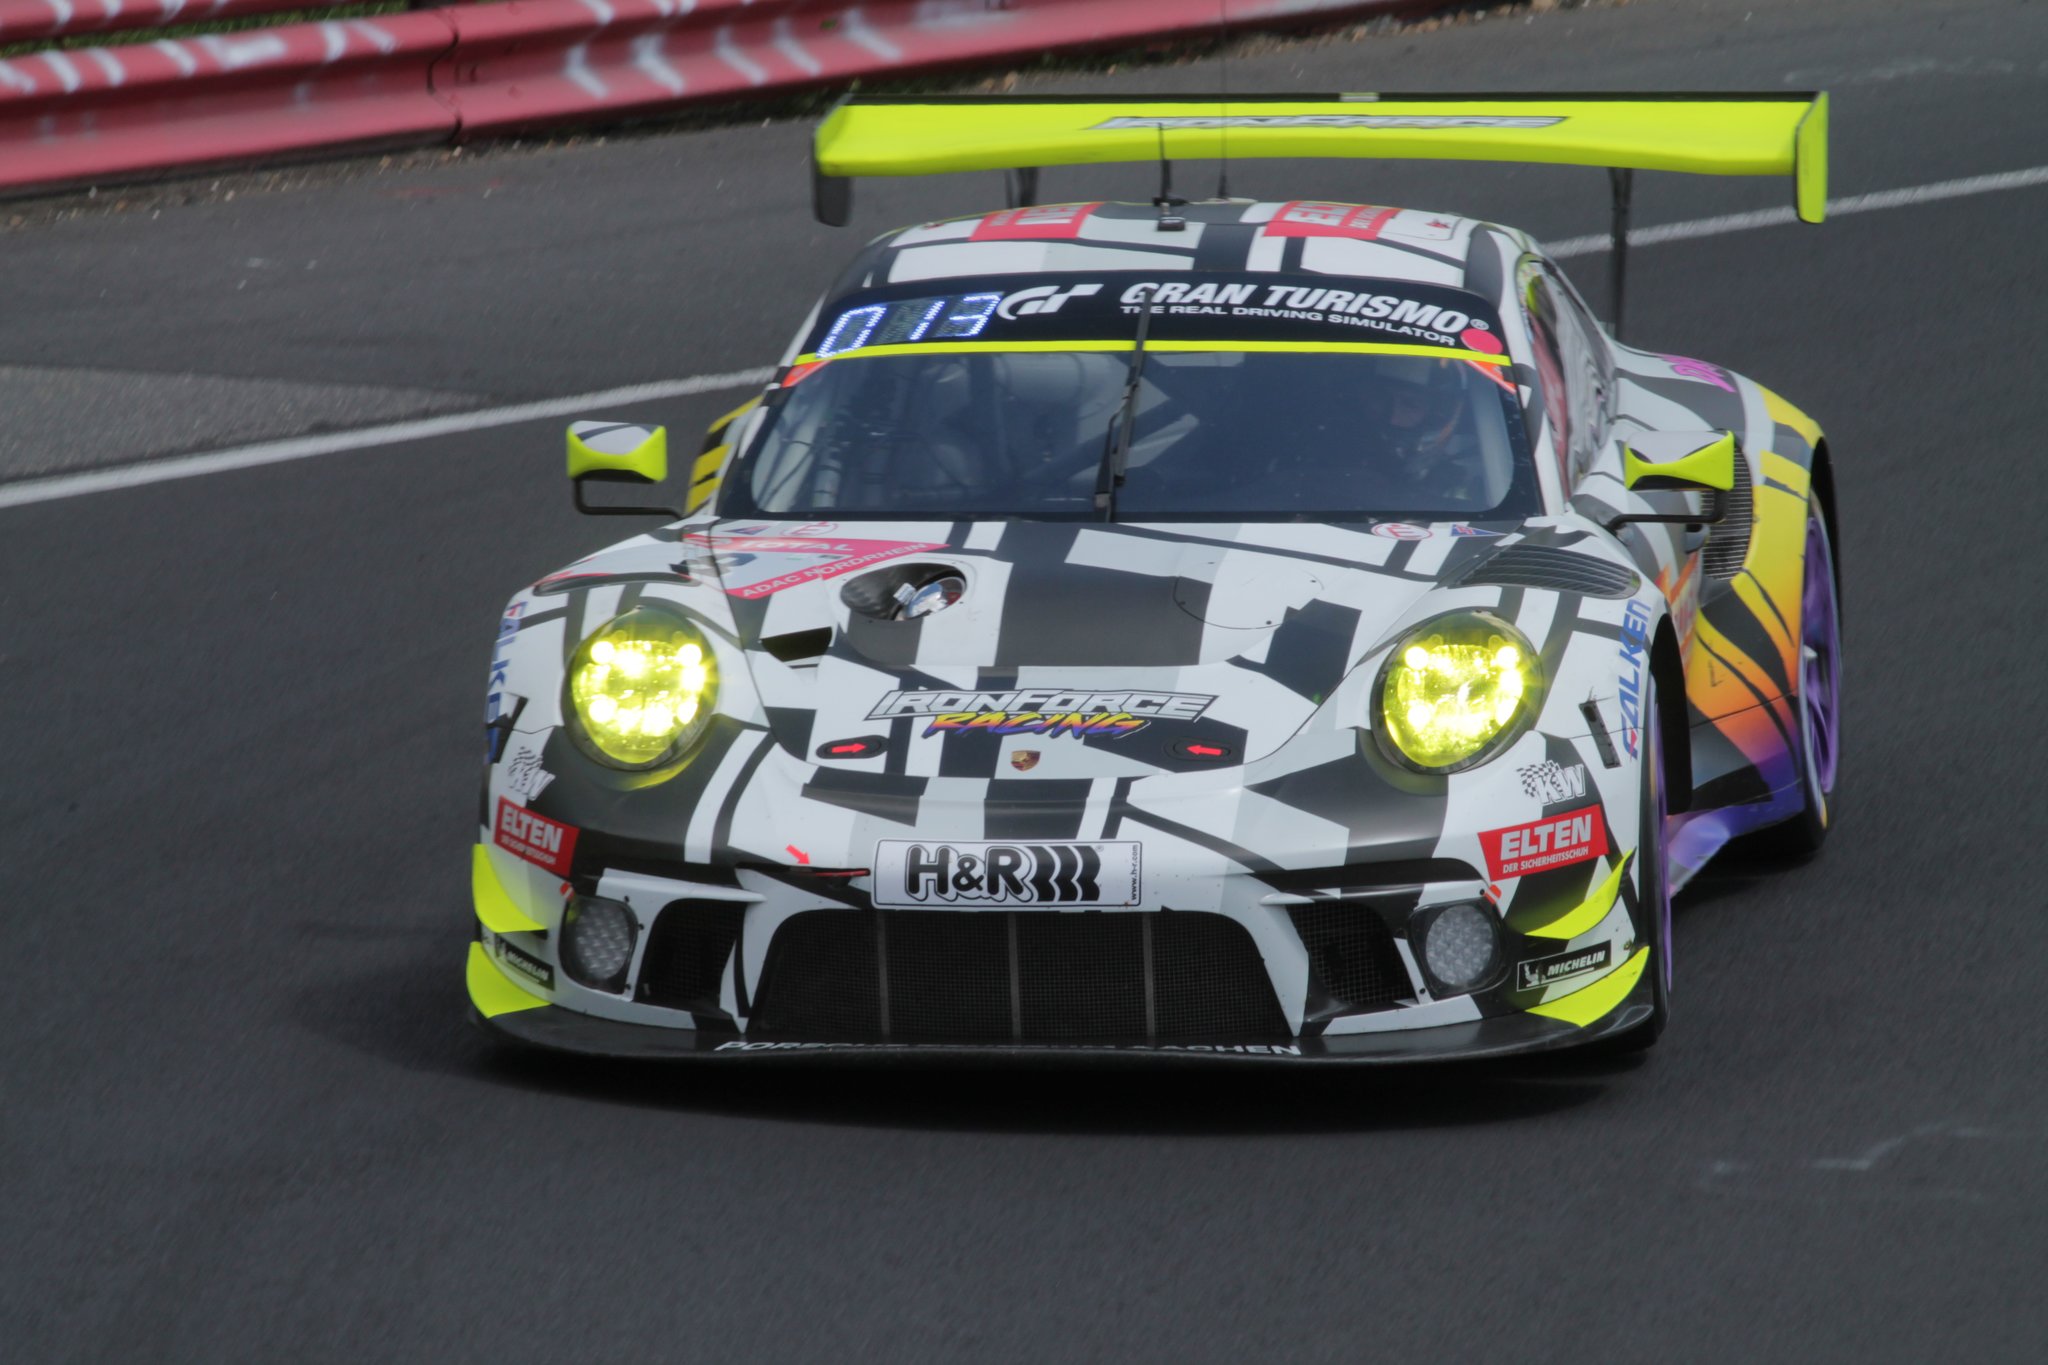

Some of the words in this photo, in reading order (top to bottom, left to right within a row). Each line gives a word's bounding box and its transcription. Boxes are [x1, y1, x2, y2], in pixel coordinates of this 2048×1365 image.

[816, 292, 1002, 358] 013
[1119, 282, 1258, 304] GRAN
[1263, 285, 1470, 334] TURISMO
[1169, 305, 1228, 315] REAL
[1231, 307, 1324, 321] DRIVING
[1327, 314, 1456, 346] SIMULATOR
[740, 540, 855, 552] TOTAL
[741, 574, 802, 598] ADAC
[804, 543, 927, 578] NORDRHEIN
[1618, 599, 1652, 760] FALKEN
[863, 689, 1220, 722] IRONFORCE
[921, 711, 1148, 740] RACING
[1534, 763, 1586, 806] KW
[501, 804, 564, 853] ELTEN
[1500, 814, 1592, 861] ELTEN
[905, 844, 1034, 902] H&R
[1502, 863, 1519, 874] DER
[1520, 846, 1589, 870] SICHERHEITSSCHUH
[1546, 950, 1606, 976] MICHELIN
